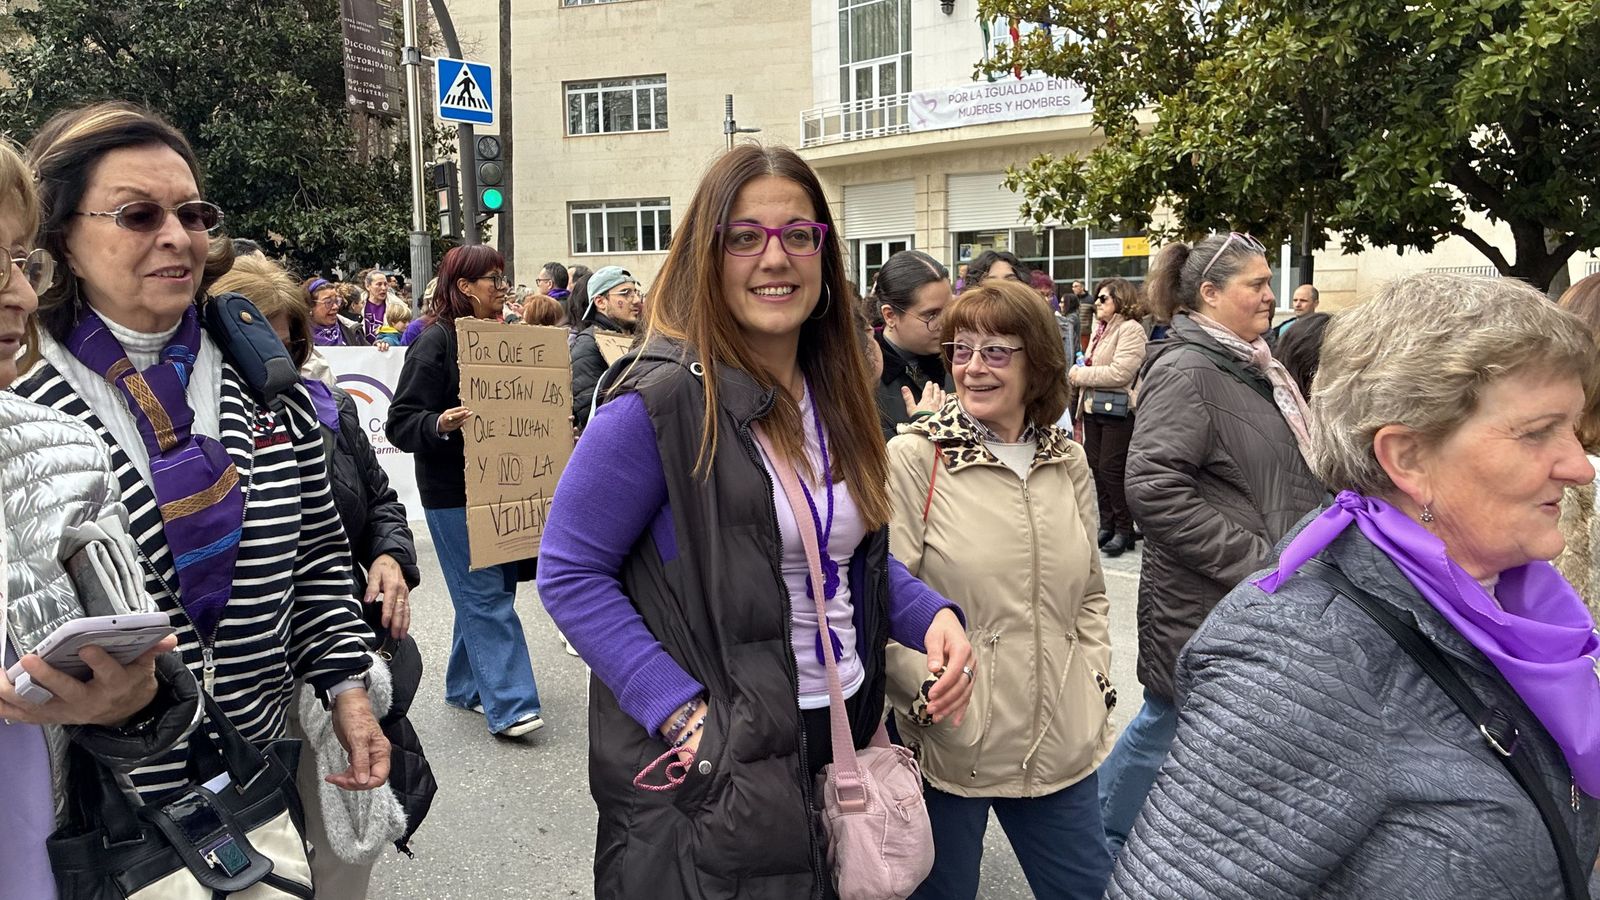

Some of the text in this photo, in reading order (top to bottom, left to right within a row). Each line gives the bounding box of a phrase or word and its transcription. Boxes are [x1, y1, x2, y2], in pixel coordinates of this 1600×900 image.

[344, 37, 393, 58] DICCIONARIO
[345, 53, 396, 72] AUTORIDADES
[948, 92, 969, 104] POR
[970, 89, 983, 100] LA
[985, 81, 1044, 98] IGUALDAD
[958, 95, 1071, 118] MUJERES Y HOMBRES
[467, 330, 545, 363] POR QUÉ TE
[470, 375, 533, 401] MOLESTAN
[473, 414, 496, 444] QUE
[477, 454, 554, 484] Y NO LA
[488, 486, 552, 537] VIOLEN
